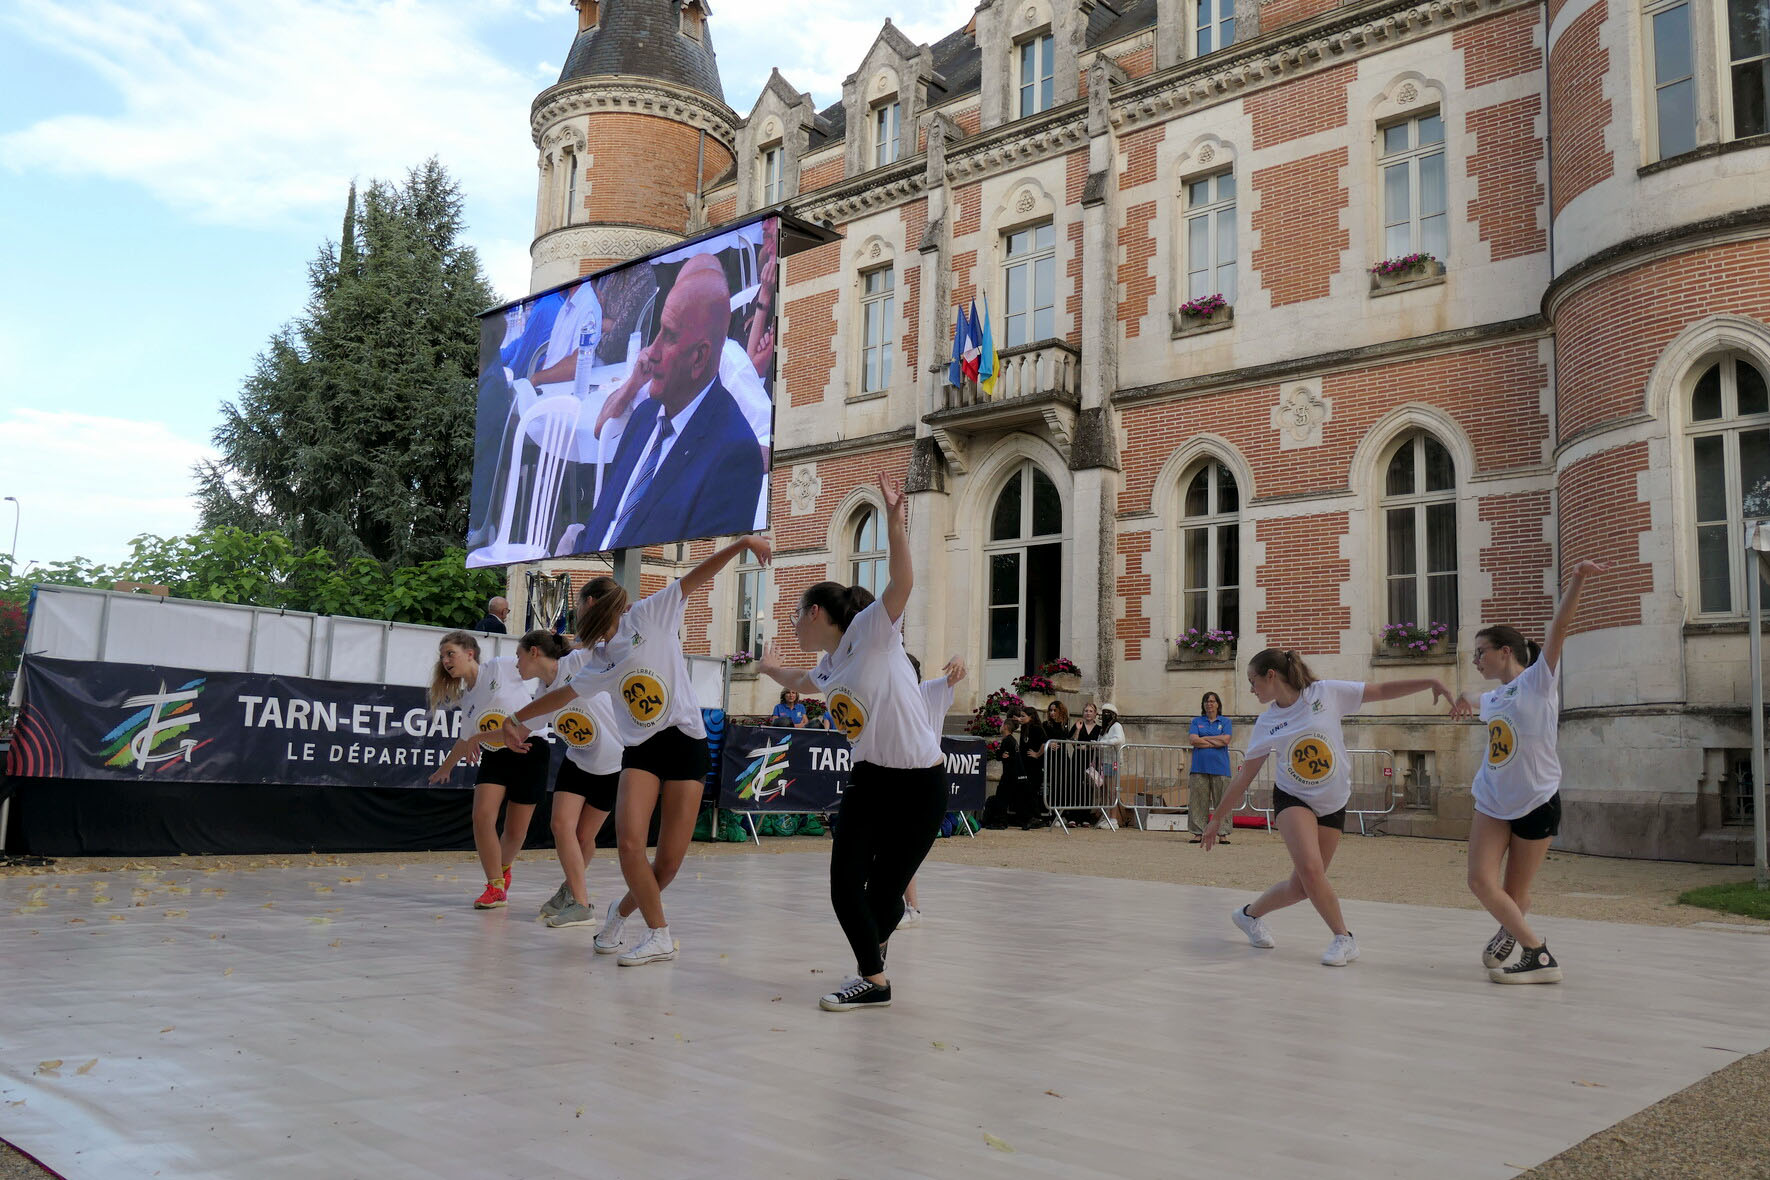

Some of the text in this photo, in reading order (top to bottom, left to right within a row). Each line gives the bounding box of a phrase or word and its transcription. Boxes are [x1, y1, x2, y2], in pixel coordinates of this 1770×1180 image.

[623, 683, 646, 704] 20
[558, 718, 578, 734] 20
[287, 742, 316, 760] LE
[1294, 745, 1318, 763] 20
[1492, 742, 1509, 757] 24
[1309, 759, 1330, 774] 24
